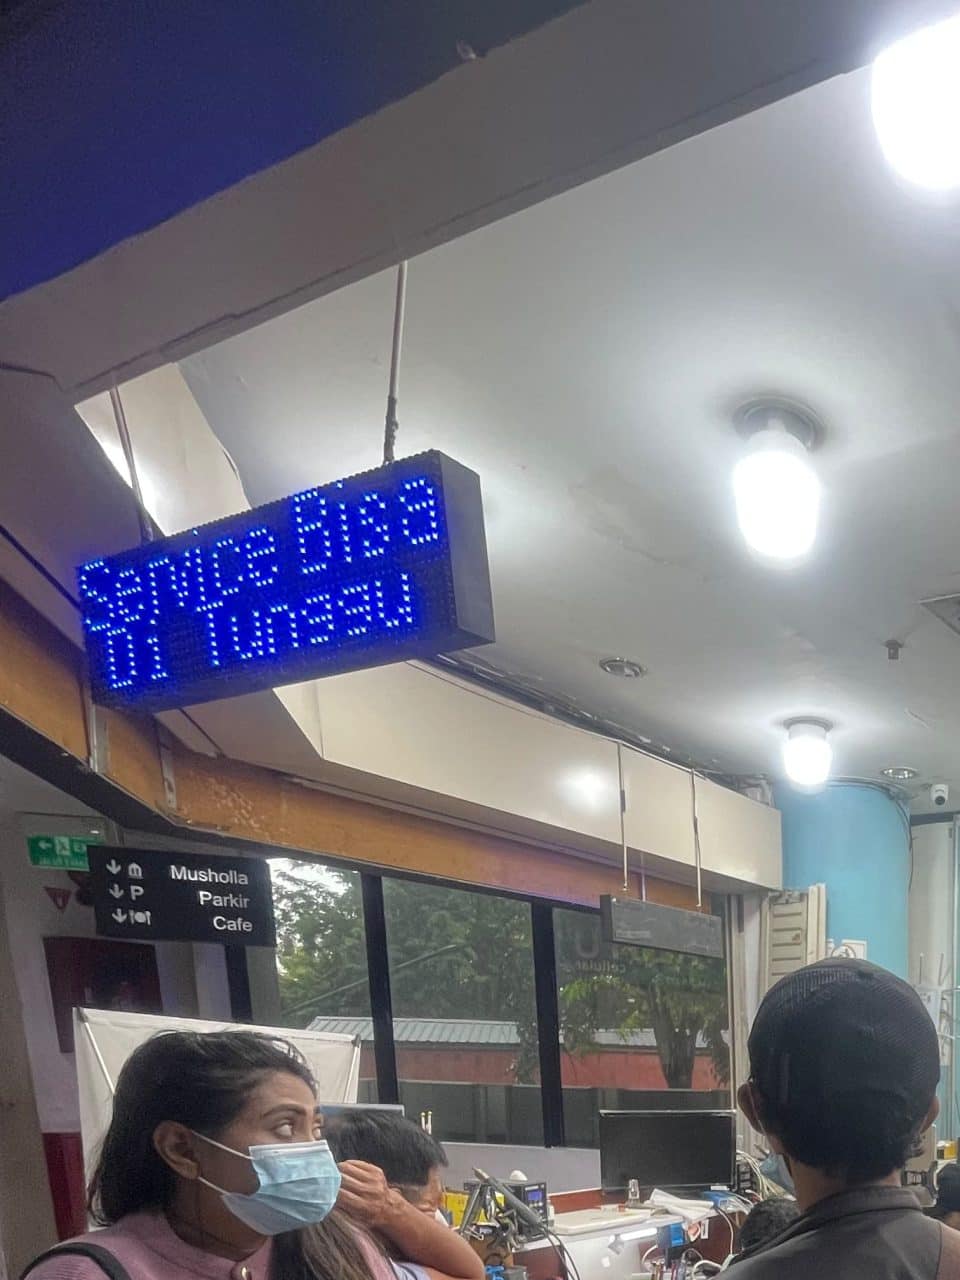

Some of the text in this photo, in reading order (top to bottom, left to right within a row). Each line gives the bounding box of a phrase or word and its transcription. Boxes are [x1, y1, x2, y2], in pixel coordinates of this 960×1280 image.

[80, 526, 278, 634] Service
[170, 864, 249, 886] Musholla
[199, 890, 250, 909] Parkir
[213, 915, 253, 932] Cafe
